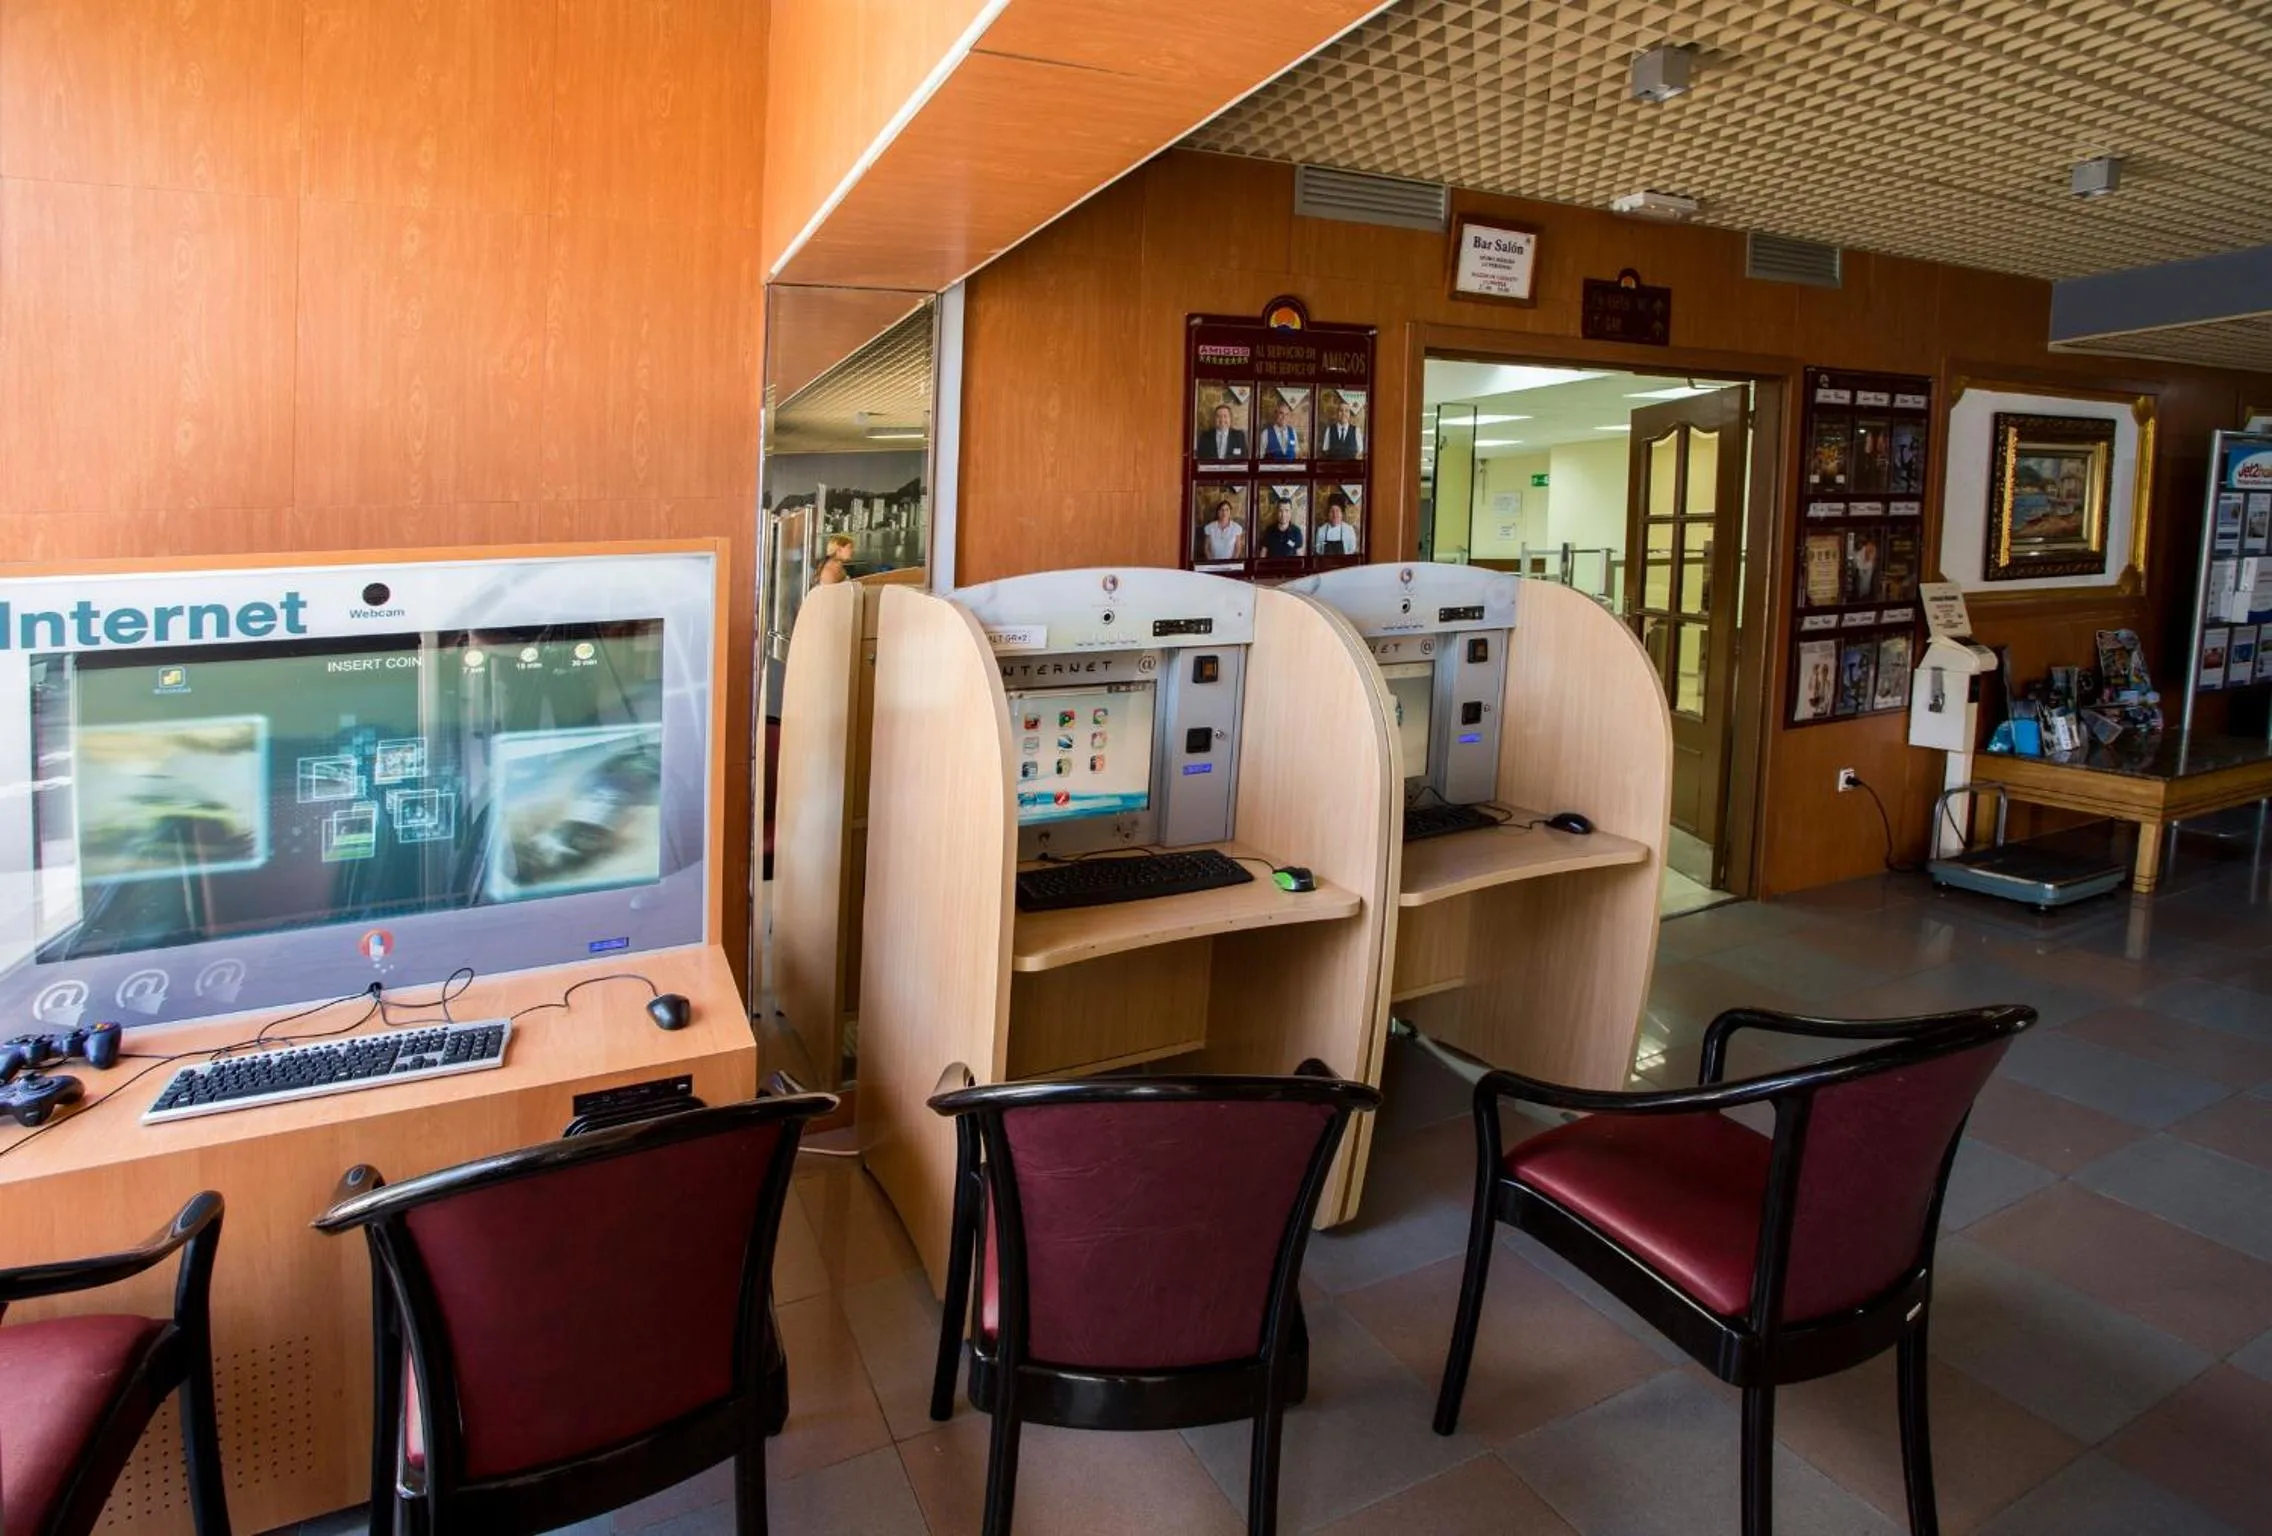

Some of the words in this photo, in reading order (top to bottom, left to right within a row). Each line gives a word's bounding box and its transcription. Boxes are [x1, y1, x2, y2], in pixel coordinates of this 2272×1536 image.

[1473, 236, 1492, 250] Bar
[1495, 239, 1524, 255] Salón
[1200, 346, 1249, 355] AMIGOS
[1322, 351, 1366, 376] AMIGOS
[0, 592, 307, 650] Internet
[350, 608, 405, 619] Webcam
[328, 658, 381, 673] INSERT
[386, 657, 422, 669] COIN
[1002, 660, 1112, 677] NTERNET
